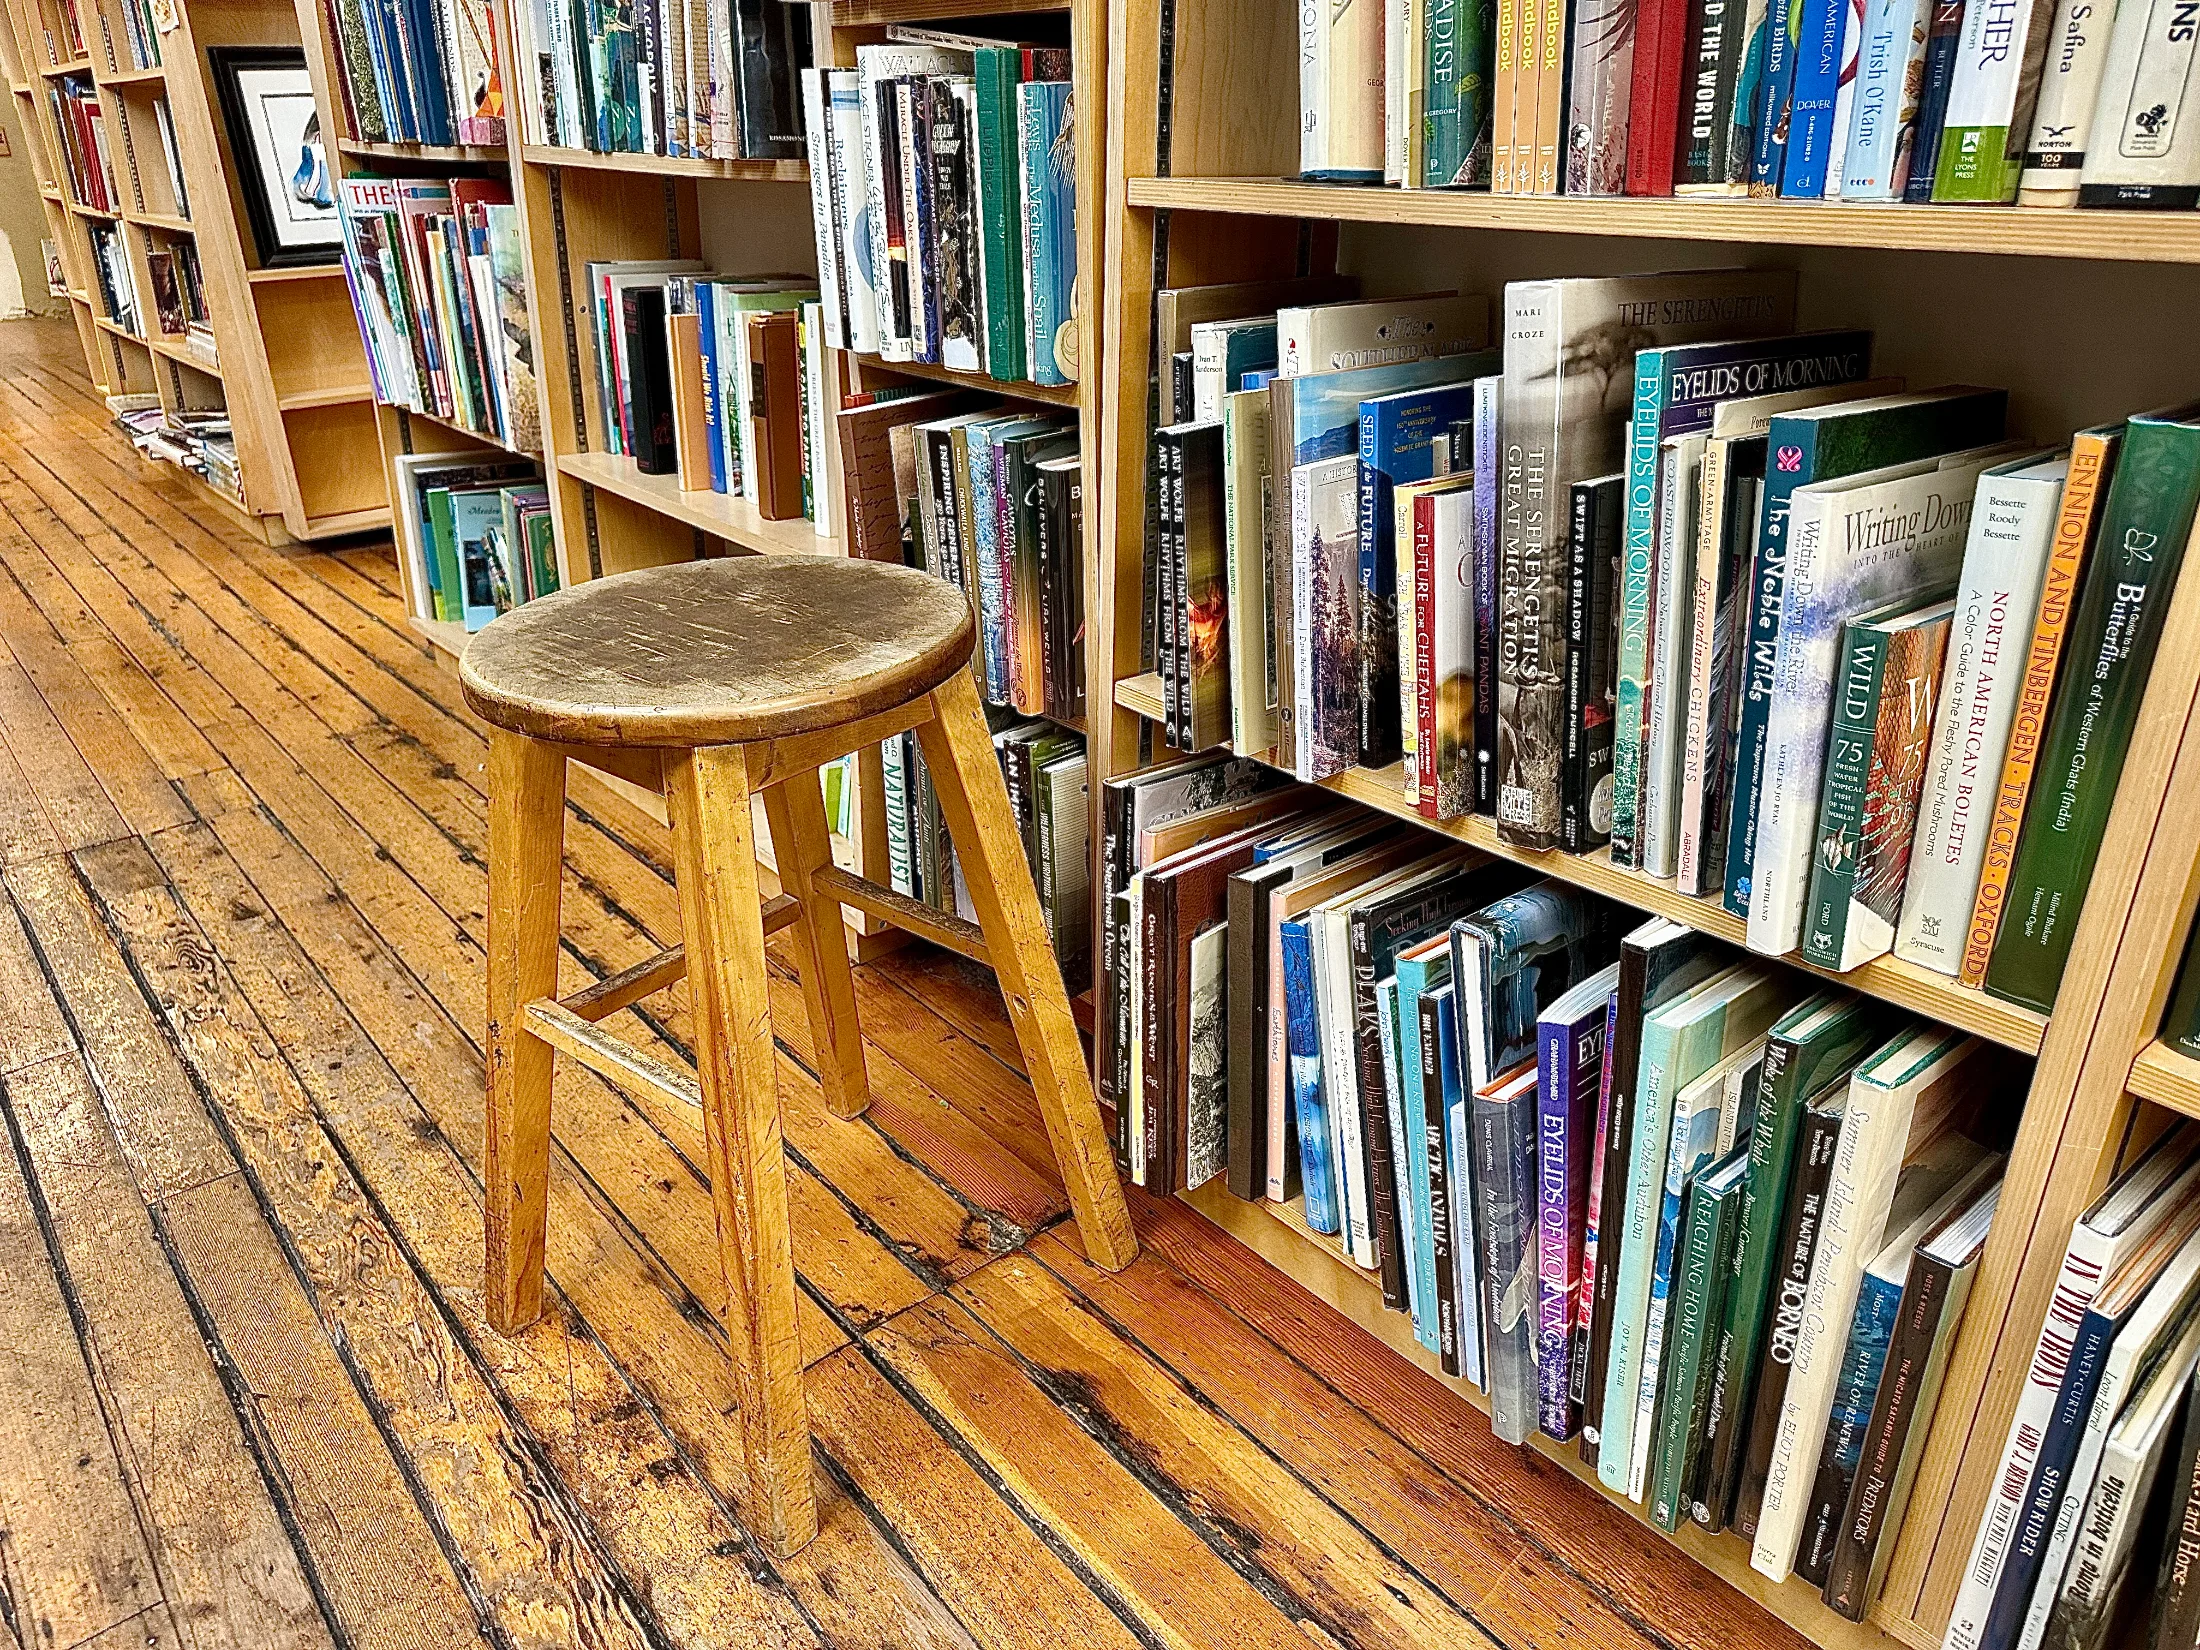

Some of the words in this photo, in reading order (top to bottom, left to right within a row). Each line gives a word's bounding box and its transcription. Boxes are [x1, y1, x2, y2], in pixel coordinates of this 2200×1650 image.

[1434, 0, 1454, 84] ADISE
[1700, 25, 1722, 62] THE
[1769, 27, 1786, 73] BIRDS
[1819, 0, 1837, 75] AMERICAN
[1866, 31, 1893, 80] Trish
[1978, 0, 2016, 70] HER
[2060, 5, 2092, 73] Safina
[859, 56, 871, 121] WALLACE
[879, 54, 956, 76] WALLACE
[899, 91, 909, 142] MIRACLE
[1031, 106, 1043, 151] Lewis
[1428, 108, 1457, 117] GREGORY
[1692, 70, 1718, 139] WORLD
[1764, 86, 1775, 126] milkweed
[1796, 100, 1832, 111] DOVER
[1858, 87, 1885, 148] O'Kane
[811, 131, 825, 197] Strangers
[864, 125, 875, 183] STEGNER
[902, 145, 911, 184] UNDER
[1955, 163, 1977, 171] LYONS
[1955, 171, 1975, 179] PRESS
[2041, 154, 2061, 163] 100
[817, 201, 826, 216] in
[835, 139, 850, 231] Reclaimers
[905, 185, 913, 208] THE
[906, 211, 915, 242] OAKS
[1029, 185, 1043, 258] Medusa
[819, 221, 832, 281] Paradise
[1032, 295, 1047, 339] Snail
[1511, 330, 1545, 339] CROZE
[1515, 309, 1542, 317] MARI
[1618, 301, 1657, 327] THE
[700, 354, 711, 381] Should
[703, 382, 712, 395] We
[1671, 366, 1740, 402] EYELIDS
[1745, 364, 1770, 392] OF
[1773, 354, 1858, 391] MORNING
[704, 396, 713, 414] Risk
[706, 414, 715, 426] It?
[1633, 375, 1659, 477] EYELIDS
[1158, 444, 1168, 467] ART
[1171, 446, 1181, 469] ART
[1361, 414, 1375, 458] SEED
[939, 444, 956, 517] INSPIRING
[999, 457, 1007, 499] WEISMAN
[1159, 470, 1169, 521] WOLFE
[1173, 471, 1184, 523] WOLFE
[1507, 445, 1523, 531] GREAT
[1527, 447, 1545, 501] THE
[1006, 493, 1017, 557] GAVIOTAS
[1038, 478, 1048, 560] BELIEVERS
[1360, 486, 1374, 552] FUTURE
[1575, 494, 1586, 541] SWIFT
[1631, 484, 1653, 521] OF
[1703, 451, 1717, 551] GREEN-ARMYTAGE
[1989, 496, 2026, 509] Bessette
[1989, 513, 2020, 526] Roody
[2056, 453, 2097, 560] ENNION
[962, 533, 970, 551] LAND
[1001, 509, 1010, 563] GAVIOTAS
[1795, 518, 1822, 577] Writing
[1845, 506, 1921, 555] Writing
[1983, 528, 2020, 541] Bessette
[1160, 532, 1171, 601] RHYTHMS
[1175, 534, 1186, 604] RHYTHMS
[1416, 535, 1429, 602] FUTURE
[1625, 528, 1651, 652] MORNING
[1759, 547, 1787, 629] Noble
[1504, 538, 1521, 676] MIGRATION
[1519, 511, 1543, 678] SERENGETI'S
[1571, 576, 1583, 642] SHADOW
[1792, 581, 1814, 627] Down
[2040, 570, 2071, 626] AND
[1162, 604, 1172, 643] FROM
[1177, 607, 1188, 647] FROM
[1691, 576, 1711, 683] Extraordinary
[1965, 604, 1981, 639] Color
[1980, 591, 2009, 666] NORTH
[2098, 582, 2146, 680] Butterflies
[1417, 632, 1430, 719] CHEETAHS
[1478, 655, 1490, 714] PANDAS
[1571, 652, 1579, 706] ROSAMOND
[1749, 639, 1778, 703] Wilds
[1845, 643, 1876, 720] WILD
[1957, 643, 1973, 679] Guide
[1166, 679, 1175, 712] WILD
[1181, 684, 1191, 717] WILD
[2012, 633, 2058, 768] TINBERGEN
[1568, 709, 1577, 760] PURCELL
[1685, 687, 1703, 783] CHICKENS
[1943, 717, 1960, 754] Fleshy
[1962, 670, 1991, 779] AMERICAN
[2075, 700, 2101, 751] Western
[1836, 740, 1863, 762] 75
[1938, 756, 1954, 790] Pored
[2065, 753, 2086, 792] Ghats
[1827, 780, 1864, 794] TROPICAL
[884, 763, 909, 885] NATURALIST
[1039, 812, 1050, 859] WILDERNESS
[1827, 810, 1855, 821] WORLD
[1925, 794, 1948, 856] Mushrooms
[1945, 784, 1973, 867] BOLETES
[1989, 781, 2026, 869] TRACKS
[2051, 793, 2076, 832] (India)
[1042, 861, 1052, 898] WRITINGS
[1681, 831, 1691, 881] ABRADALE
[1104, 862, 1117, 928] Sagebrush
[1762, 870, 1772, 922] NORTHLAND
[1821, 902, 1832, 926] FORD
[1104, 932, 1115, 971] Ocean
[1910, 936, 1945, 954] Syracuse
[1965, 883, 2002, 976] OXFORD
[1354, 964, 1379, 1040] PEAKS
[1271, 1007, 1281, 1062] Earthtones
[1764, 1044, 1787, 1080] Wake
[1426, 1121, 1443, 1183] ARCTIC
[1543, 1113, 1565, 1205] EYELIDS
[1752, 1122, 1774, 1167] Whale
[1841, 1105, 1870, 1173] Summer
[1430, 1187, 1448, 1257] ANIMALS
[1544, 1208, 1563, 1237] OF
[1632, 1177, 1651, 1240] Audubon
[1803, 1193, 1820, 1214] THE
[1824, 1178, 1855, 1234] Island:
[1686, 1196, 1714, 1284] REACHING
[1796, 1217, 1817, 1262] NATURE
[1423, 1256, 1433, 1296] PORTER
[1811, 1237, 1842, 1311] Penobscot
[2064, 1250, 2103, 1284] IN
[1541, 1240, 1565, 1349] MORNING
[1680, 1288, 1701, 1340] HOME
[2049, 1282, 2094, 1330] THE
[1771, 1275, 1808, 1365] BORNEO
[1794, 1313, 1825, 1375] Country
[1851, 1350, 1872, 1385] RIVER
[2030, 1328, 2075, 1393] IRONS
[2097, 1370, 2119, 1396] Leon
[1834, 1407, 1858, 1460] RENEWAL
[2088, 1394, 2110, 1433] Harrel
[1778, 1419, 1798, 1464] ELIOT
[1767, 1465, 1790, 1511] PORTER
[1999, 1461, 2030, 1505] BENSON
[2036, 1466, 2061, 1514] SHOW
[1853, 1475, 1885, 1544] PREDATORS
[2054, 1495, 2080, 1543] CUTTING
[2018, 1514, 2043, 1557] RIDER
